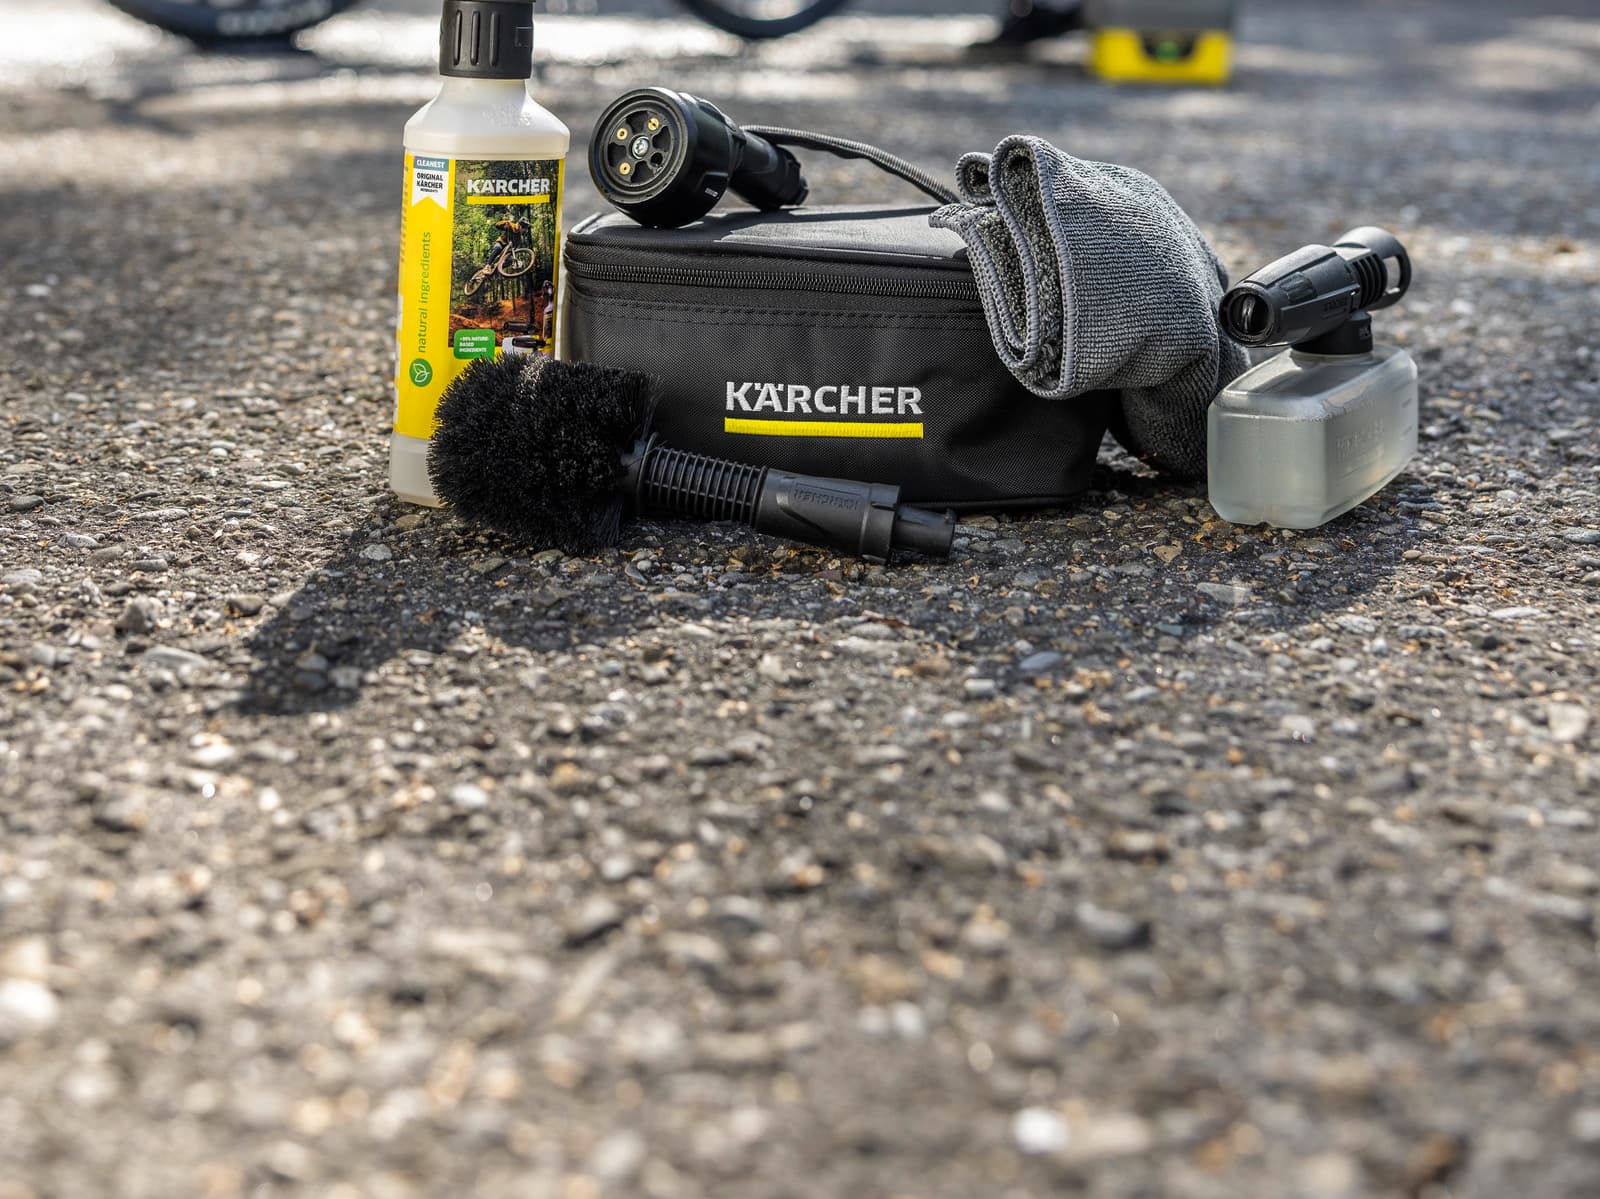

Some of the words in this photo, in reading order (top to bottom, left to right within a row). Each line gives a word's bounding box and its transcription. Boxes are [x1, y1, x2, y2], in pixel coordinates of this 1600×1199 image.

[416, 159, 445, 168] CLEANEST
[416, 172, 444, 181] ORIGINAL
[466, 178, 551, 194] KÄRCHER
[420, 231, 432, 304] ingredients
[417, 307, 428, 353] natural
[725, 381, 924, 415] KÄRCHER
